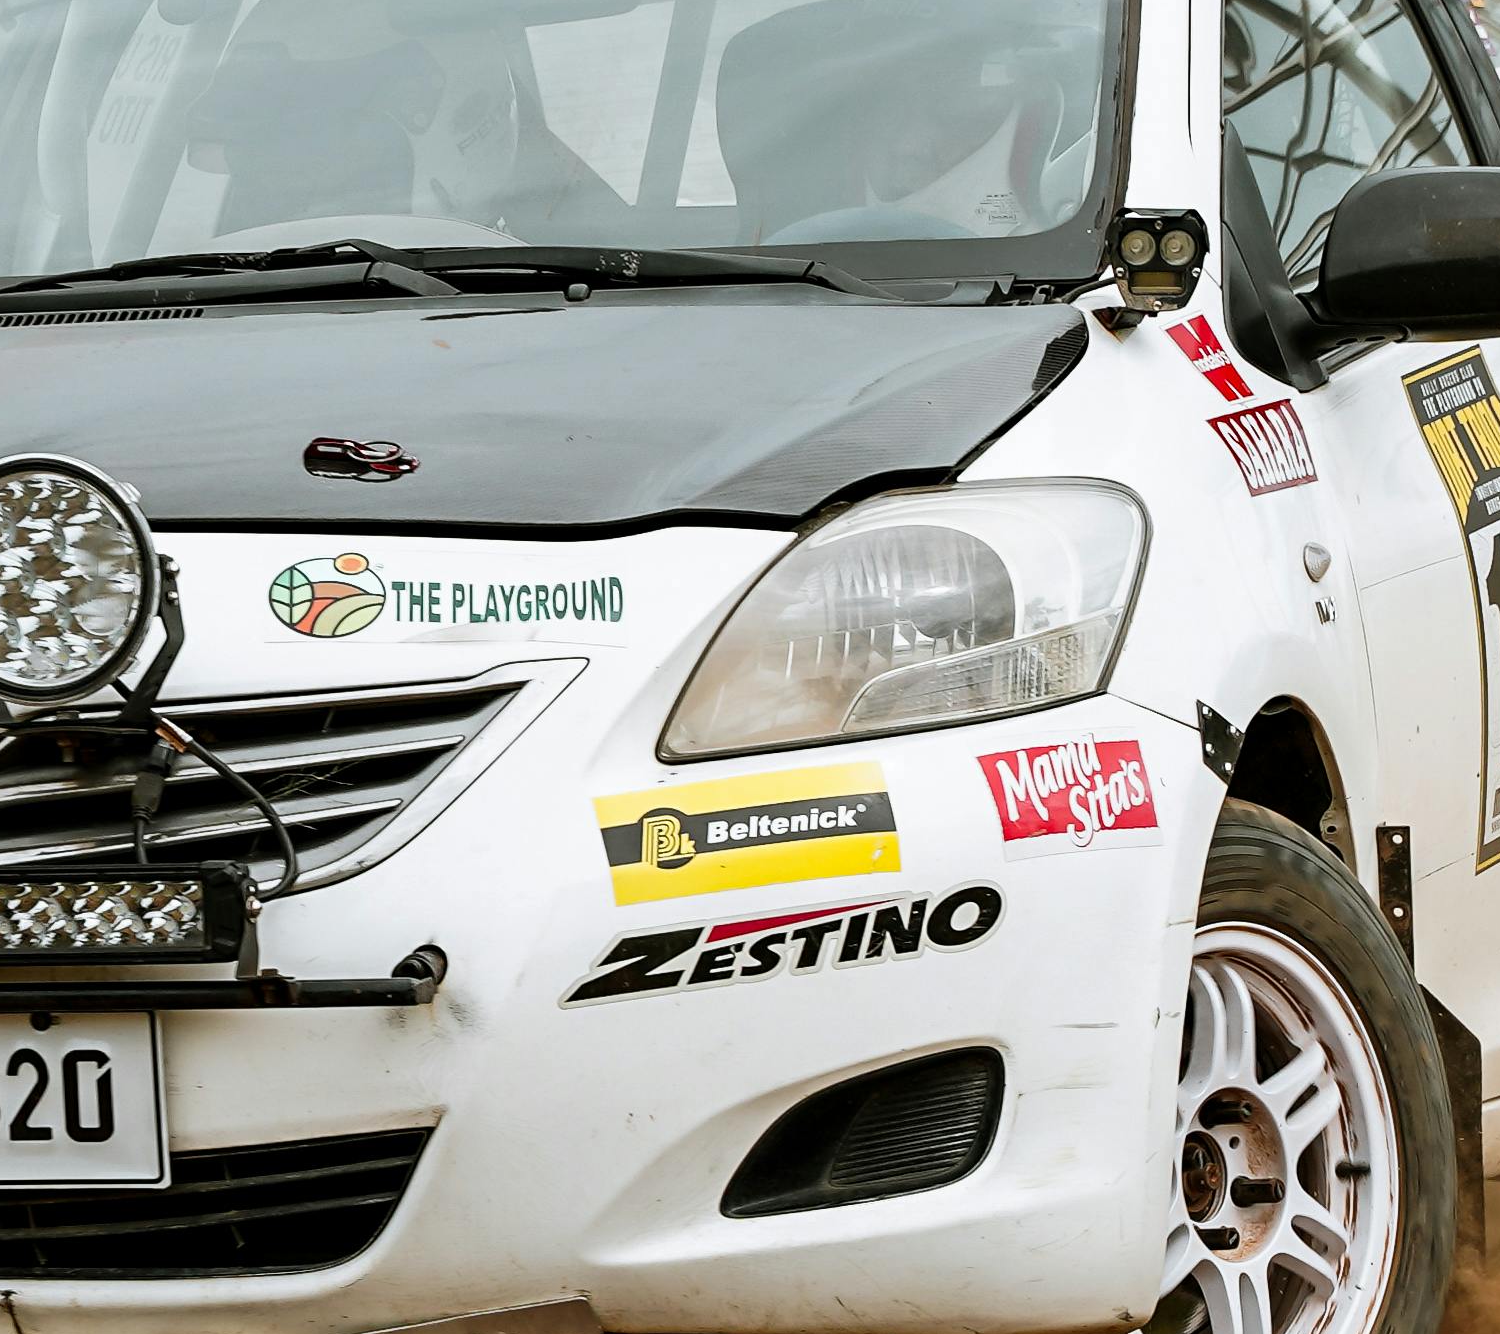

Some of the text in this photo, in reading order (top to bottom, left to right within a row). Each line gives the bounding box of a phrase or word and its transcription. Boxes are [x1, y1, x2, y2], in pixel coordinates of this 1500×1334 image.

[1216, 403, 1316, 491] SAHARA
[391, 576, 624, 624] THE PLAYGROUND
[995, 732, 1102, 823] Mama
[564, 885, 1002, 1004] ZESTINO
